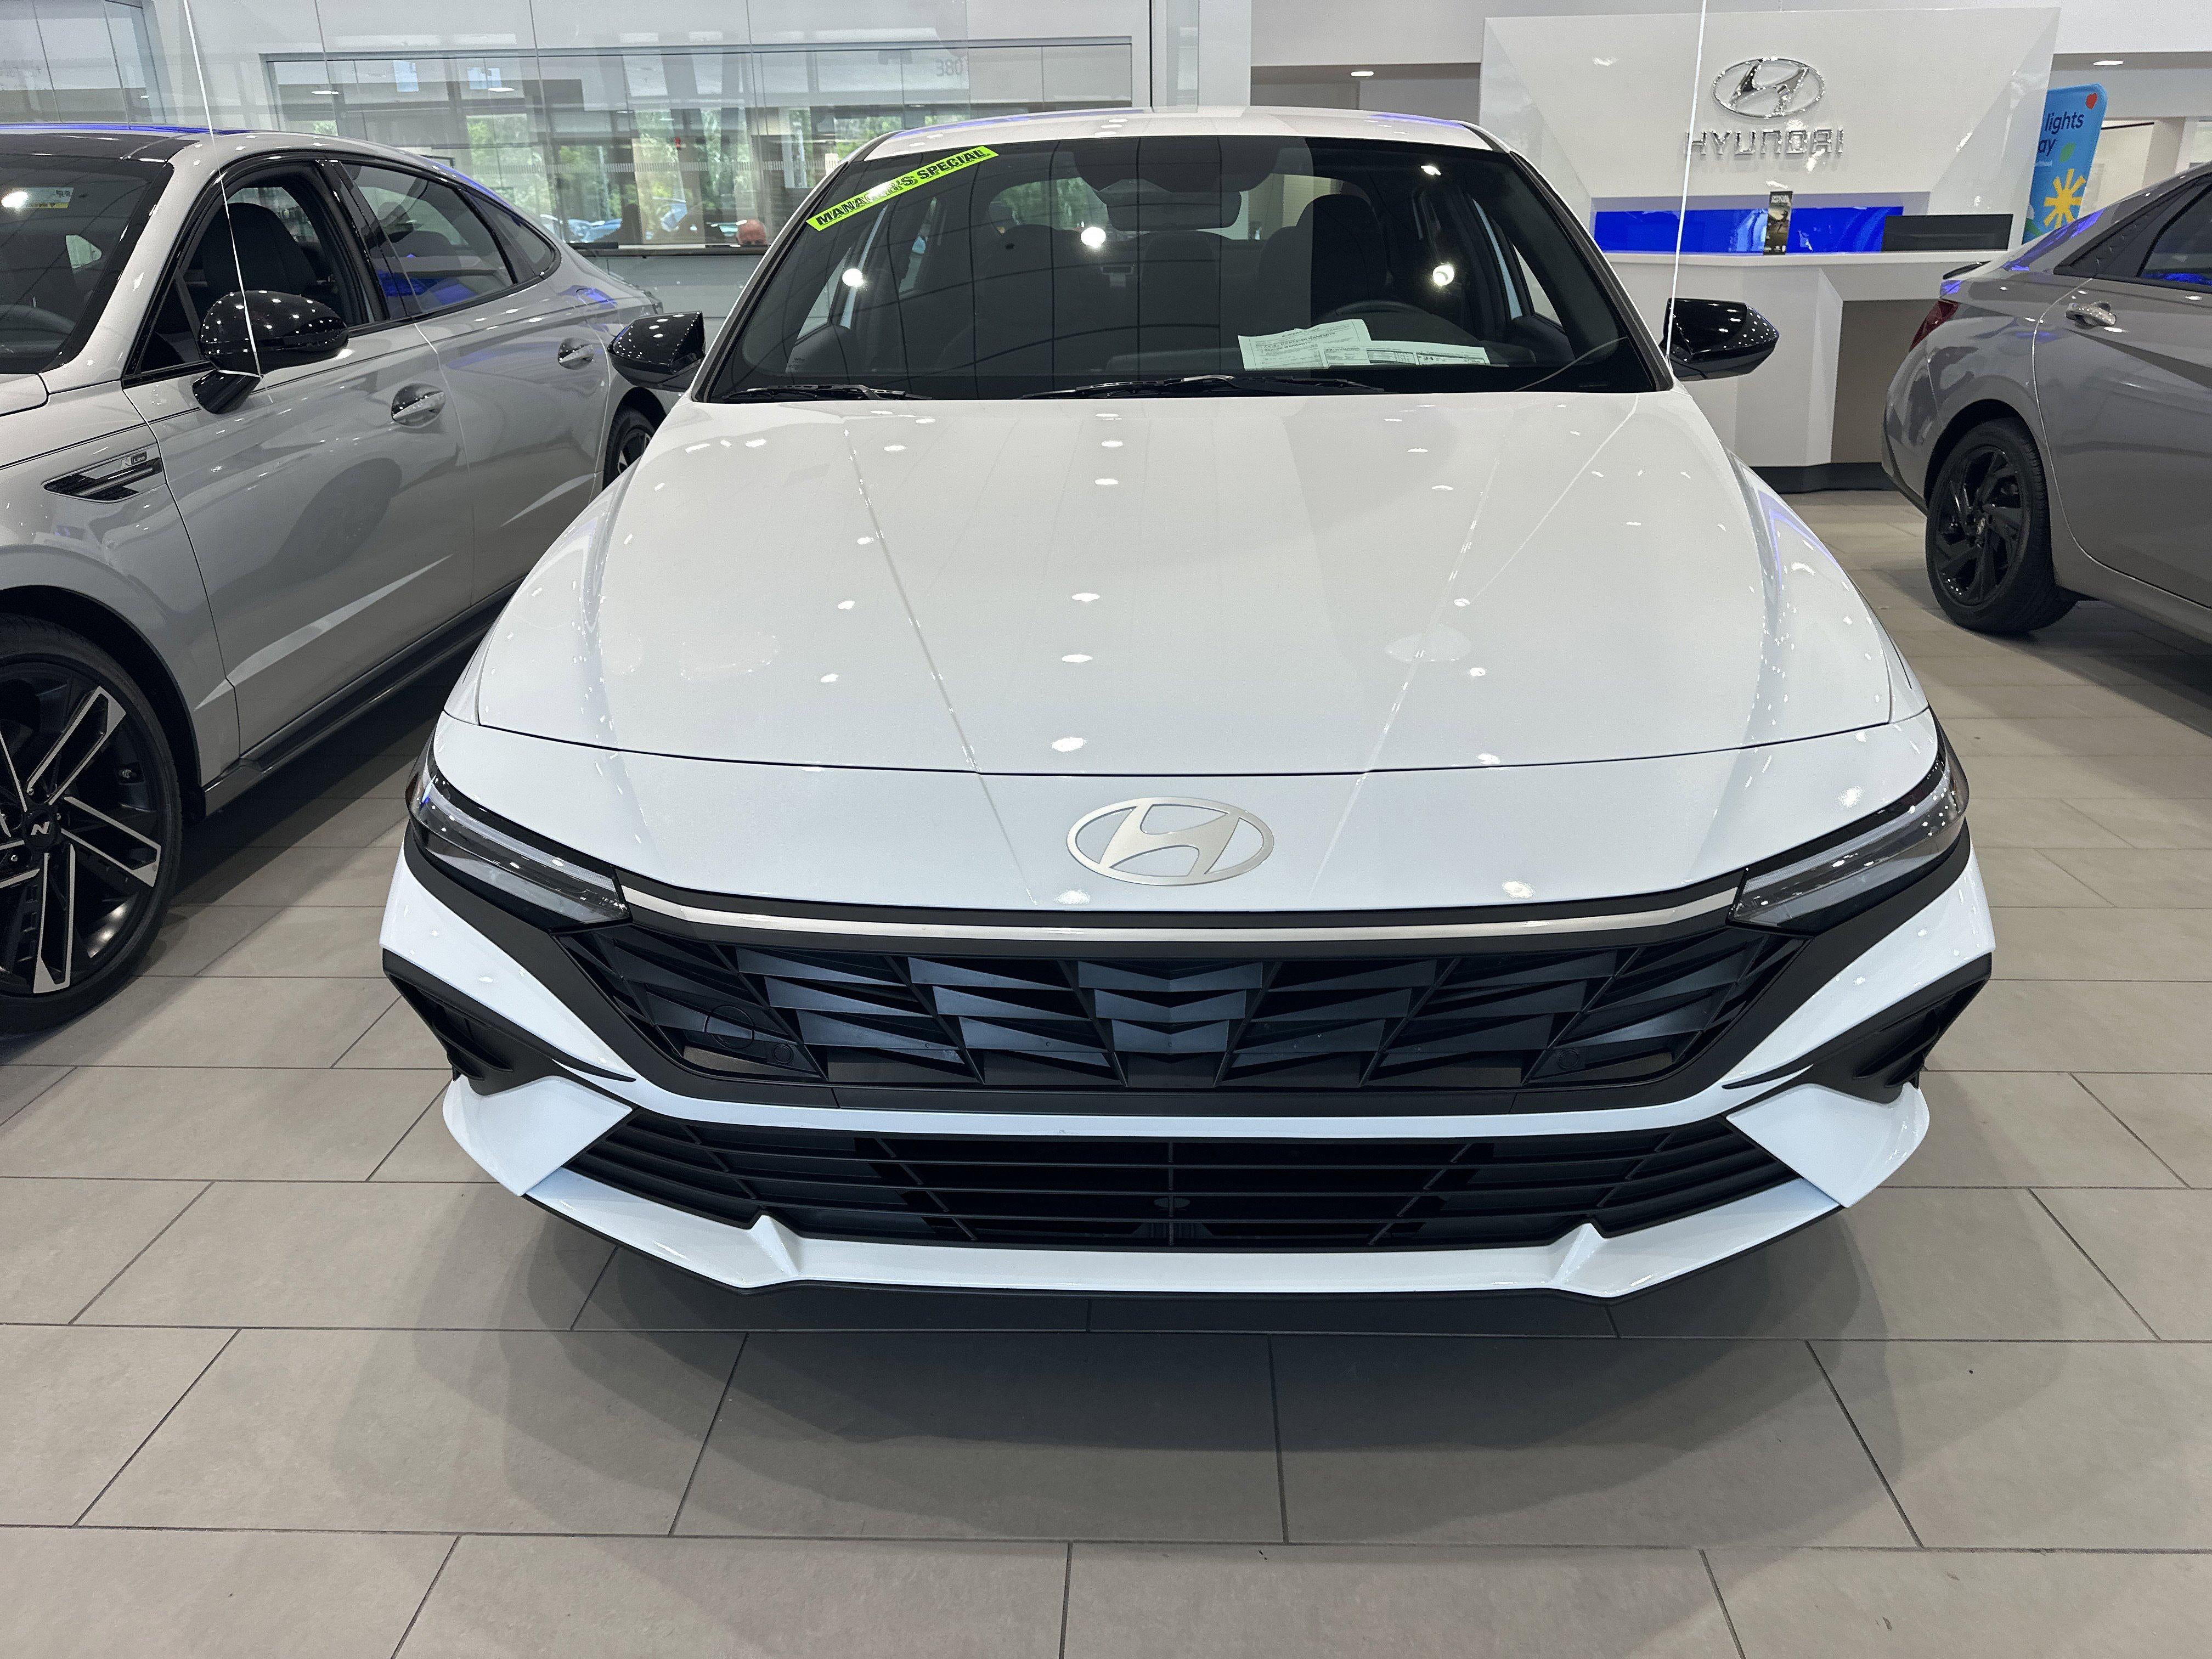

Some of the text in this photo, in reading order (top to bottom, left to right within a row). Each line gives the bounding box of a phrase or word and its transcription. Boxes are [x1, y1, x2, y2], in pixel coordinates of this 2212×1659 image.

[2045, 111, 2085, 135] lights
[1685, 127, 1844, 155] HYUNDAI
[917, 149, 988, 180] SPECIAL
